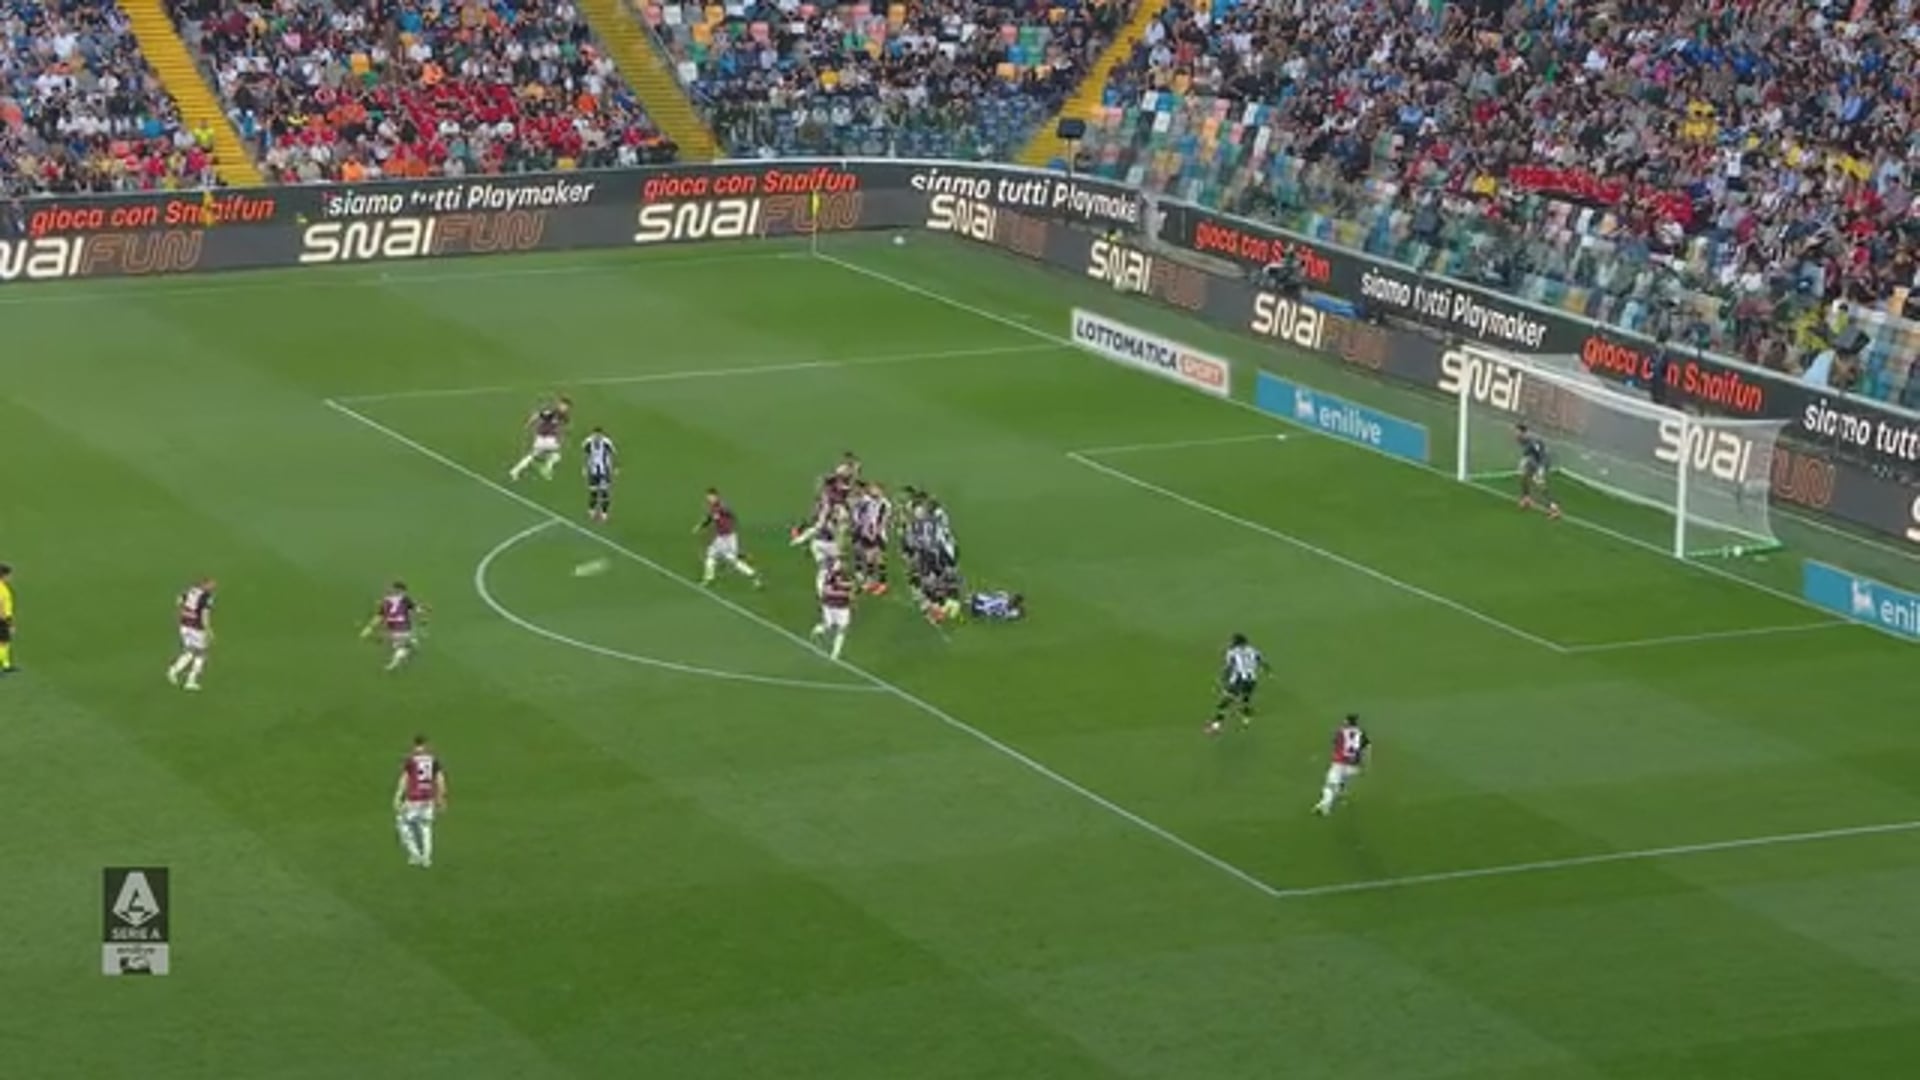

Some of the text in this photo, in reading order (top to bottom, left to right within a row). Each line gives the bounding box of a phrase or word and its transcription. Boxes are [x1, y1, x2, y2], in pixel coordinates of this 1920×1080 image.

[328, 188, 404, 217] siamo
[468, 178, 595, 210] Playmaker
[644, 173, 706, 203] gioca
[714, 174, 757, 194] con
[998, 178, 1050, 206] tutti
[30, 203, 104, 235] gioca
[111, 205, 158, 226] con
[1452, 293, 1547, 348] Playmaker
[1075, 317, 1178, 370] LOTTOMATICA
[1641, 355, 1680, 386] cn
[1320, 406, 1382, 445] enilive
